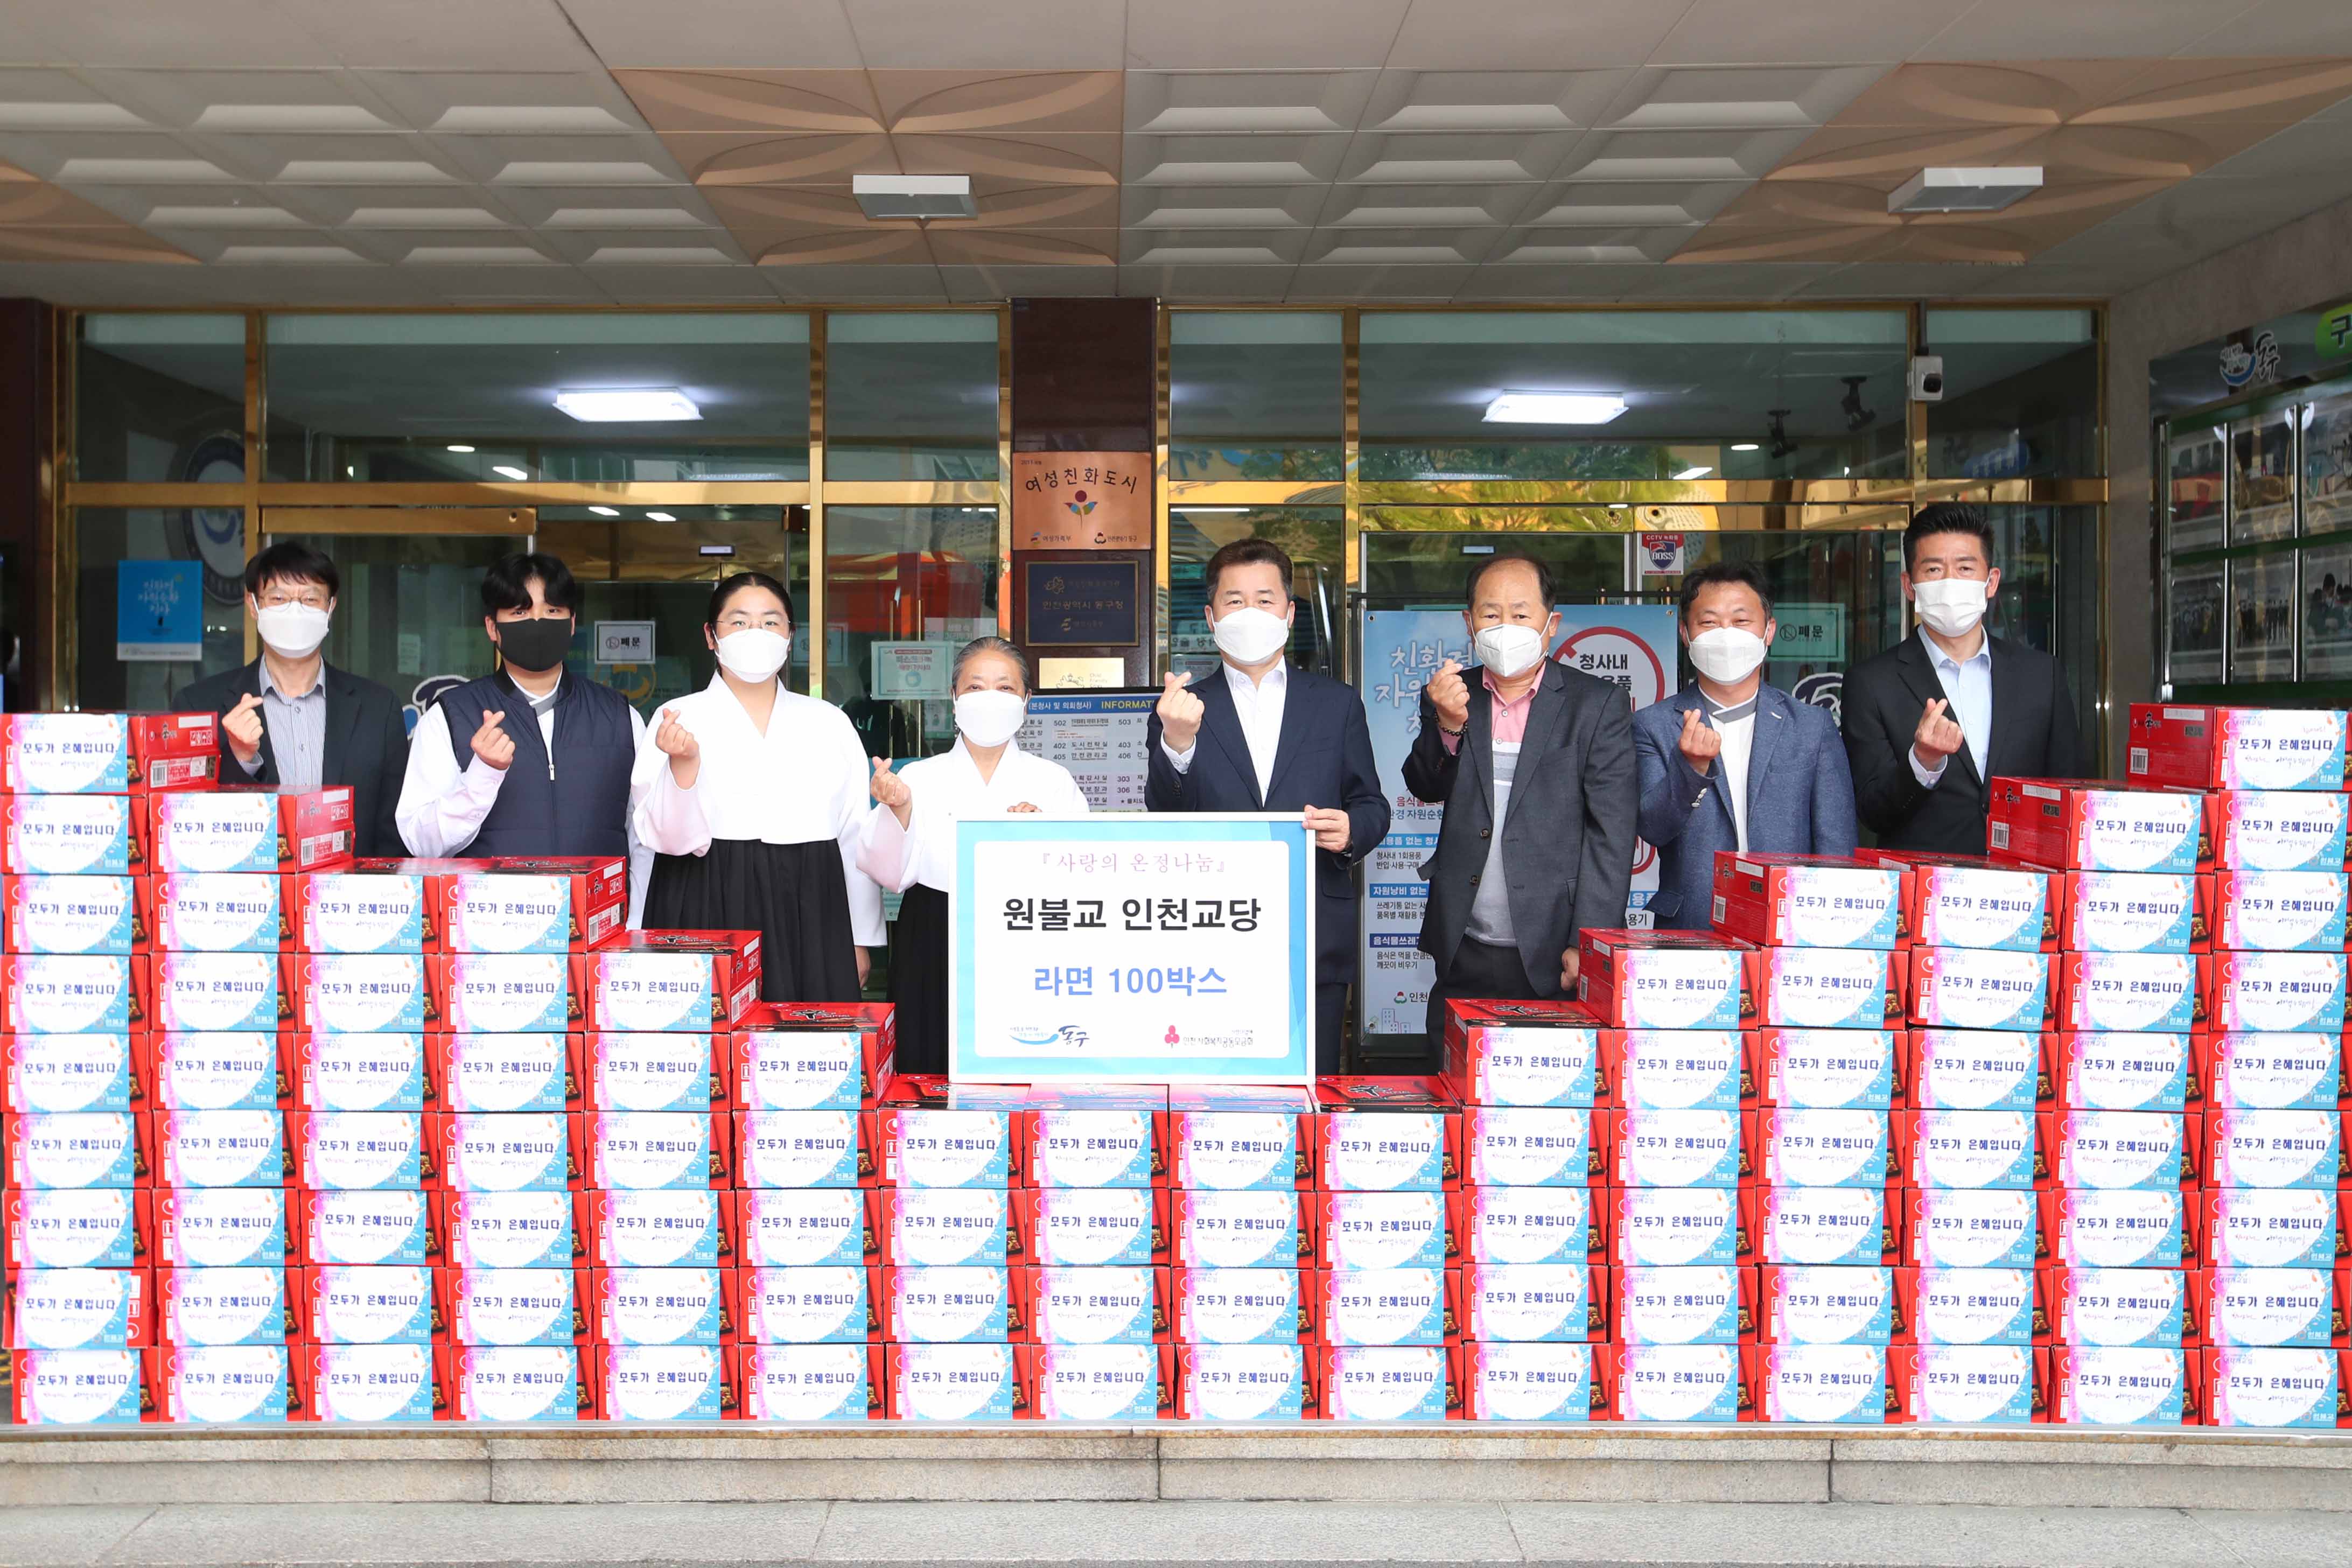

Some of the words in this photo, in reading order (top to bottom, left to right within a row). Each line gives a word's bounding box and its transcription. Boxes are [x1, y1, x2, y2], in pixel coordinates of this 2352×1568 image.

[1025, 467, 1137, 494] 여성친화도시
[1652, 551, 1674, 561] BOSS
[1579, 654, 1628, 670] 청사내
[1053, 702, 1060, 710] 및
[1101, 699, 1154, 709] INFORMAT
[2240, 739, 2272, 749] 모두가
[174, 823, 204, 832] 모두가
[2096, 820, 2126, 831] 모두가
[1405, 836, 1422, 845] 없는
[1376, 851, 1396, 860] 청사내
[1398, 851, 1422, 860] 1회용품
[1373, 886, 1407, 896] 자원낭비
[1410, 886, 1427, 896] 없는
[178, 901, 208, 910] 모두가
[1377, 901, 1402, 909] 쓰레기통
[1404, 901, 1417, 909] 없는
[1796, 896, 1826, 907] 모두가
[29, 904, 59, 913] 모두가
[467, 902, 498, 913] 모두가
[1003, 898, 1107, 932] 원불교
[1122, 898, 1262, 932] 인천교당
[1377, 911, 1396, 920] 품목별
[1398, 911, 1418, 920] 재활용
[1377, 951, 1396, 960] 음식은
[1398, 951, 1411, 960] 먹을
[1398, 961, 1418, 969] 비우기
[1034, 966, 1094, 997] 라면
[1109, 966, 1228, 997] 100박스
[1637, 979, 1668, 989] 모두가
[2242, 981, 2272, 991] 모두가
[26, 984, 55, 993] 모두가
[467, 983, 496, 993] 모두가
[1058, 1025, 1090, 1047] 동구
[609, 1061, 639, 1072] 모두가
[760, 1061, 790, 1072] 모두가
[1789, 1058, 1819, 1069] 모두가
[2084, 1059, 2115, 1069] 모두가
[180, 1138, 211, 1149] 모두가
[1487, 1136, 1517, 1146] 모두가
[1783, 1137, 1814, 1147] 모두가
[2077, 1139, 2109, 1150] 모두가
[1341, 1141, 1371, 1152] 모두가
[31, 1219, 61, 1229] 모두가
[183, 1218, 213, 1228] 모두가
[325, 1214, 355, 1224] 모두가
[762, 1217, 792, 1228] 모두가
[1051, 1216, 1081, 1227] 모두가
[2229, 1217, 2262, 1228] 모두가
[473, 1297, 503, 1307] 모두가
[619, 1296, 648, 1306] 모두가
[1197, 1295, 1227, 1305] 모두가
[1486, 1292, 1516, 1303] 모두가
[1930, 1295, 1961, 1306] 모두가
[2078, 1297, 2110, 1307] 모두가
[476, 1373, 506, 1383] 모두가
[620, 1373, 649, 1383] 모두가
[767, 1374, 796, 1384] 모두가
[1056, 1372, 1086, 1382] 모두가
[1488, 1371, 1519, 1381] 모두가
[1782, 1373, 1812, 1383] 모두가
[2080, 1375, 2111, 1385] 모두가
